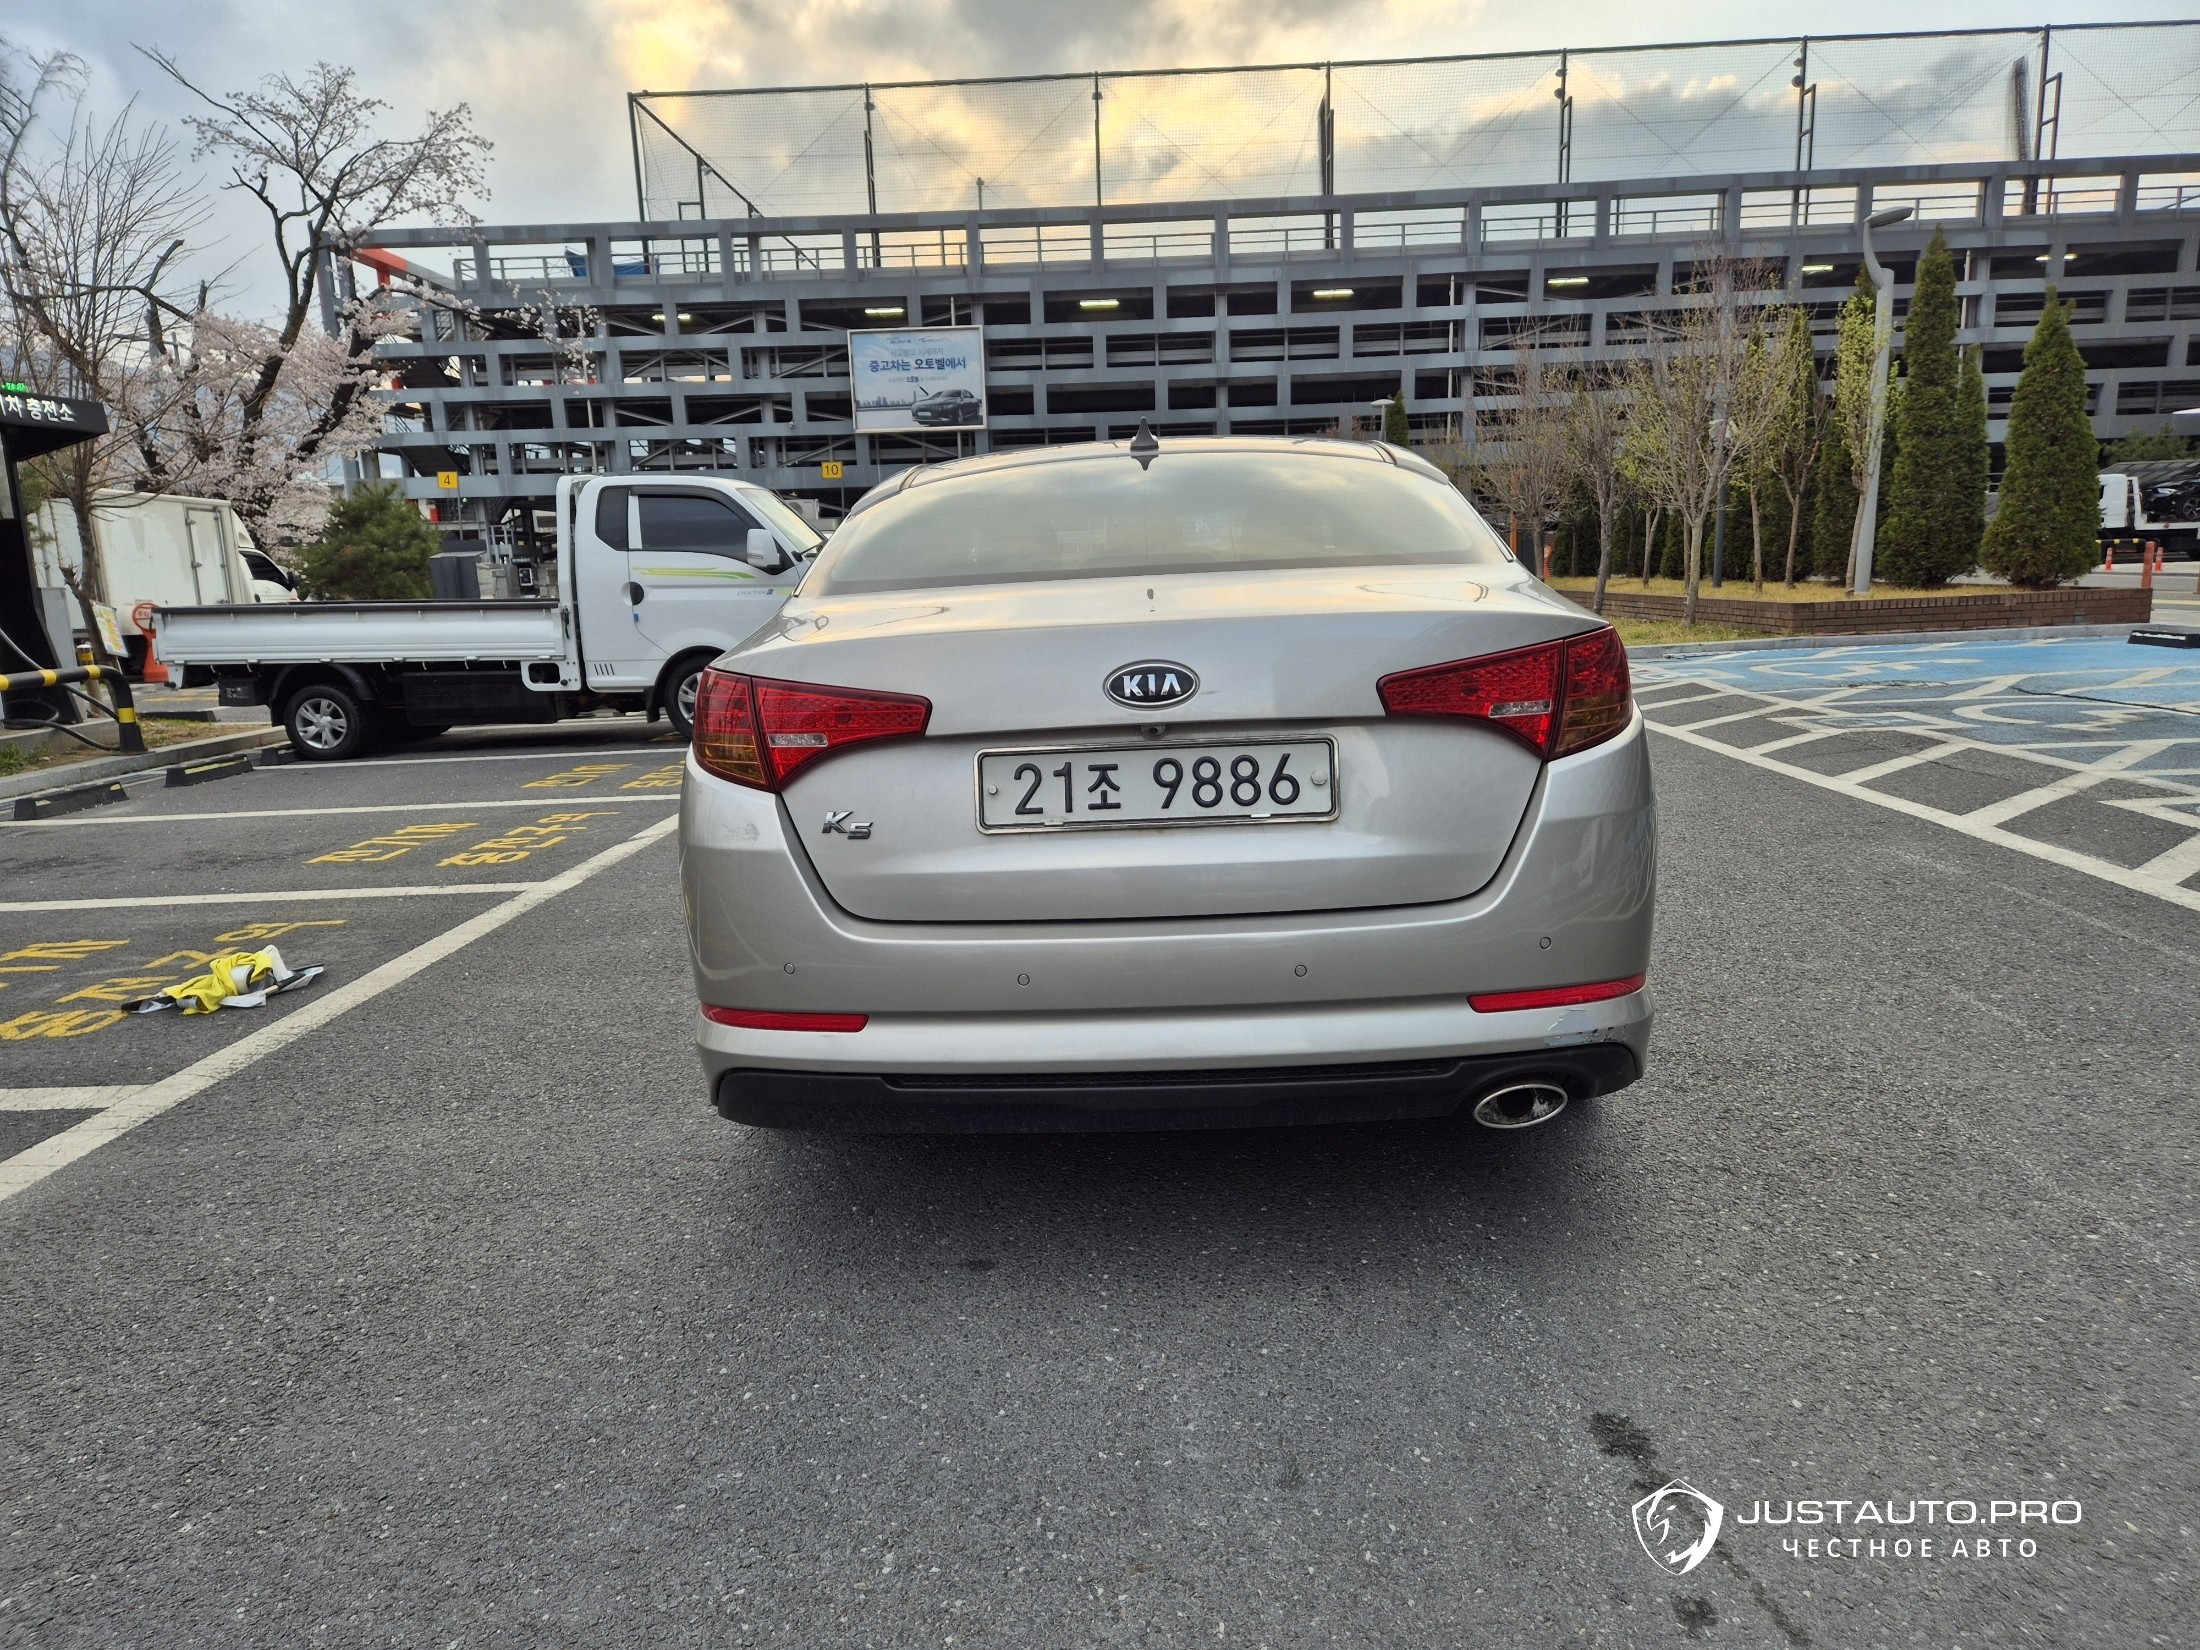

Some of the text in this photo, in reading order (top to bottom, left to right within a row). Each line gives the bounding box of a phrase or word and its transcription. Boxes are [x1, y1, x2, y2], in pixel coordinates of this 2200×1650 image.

[869, 356, 966, 372] 중고차는 오토벨에서
[26, 397, 75, 422] 충전소
[443, 474, 451, 485] 4
[825, 464, 839, 475] 10
[1123, 674, 1183, 697] KIA
[521, 763, 633, 788] 전기차
[1013, 753, 1301, 815] 21조 9886
[822, 810, 874, 840] K5
[304, 822, 479, 864] 전기차
[435, 811, 621, 867] 충전구역
